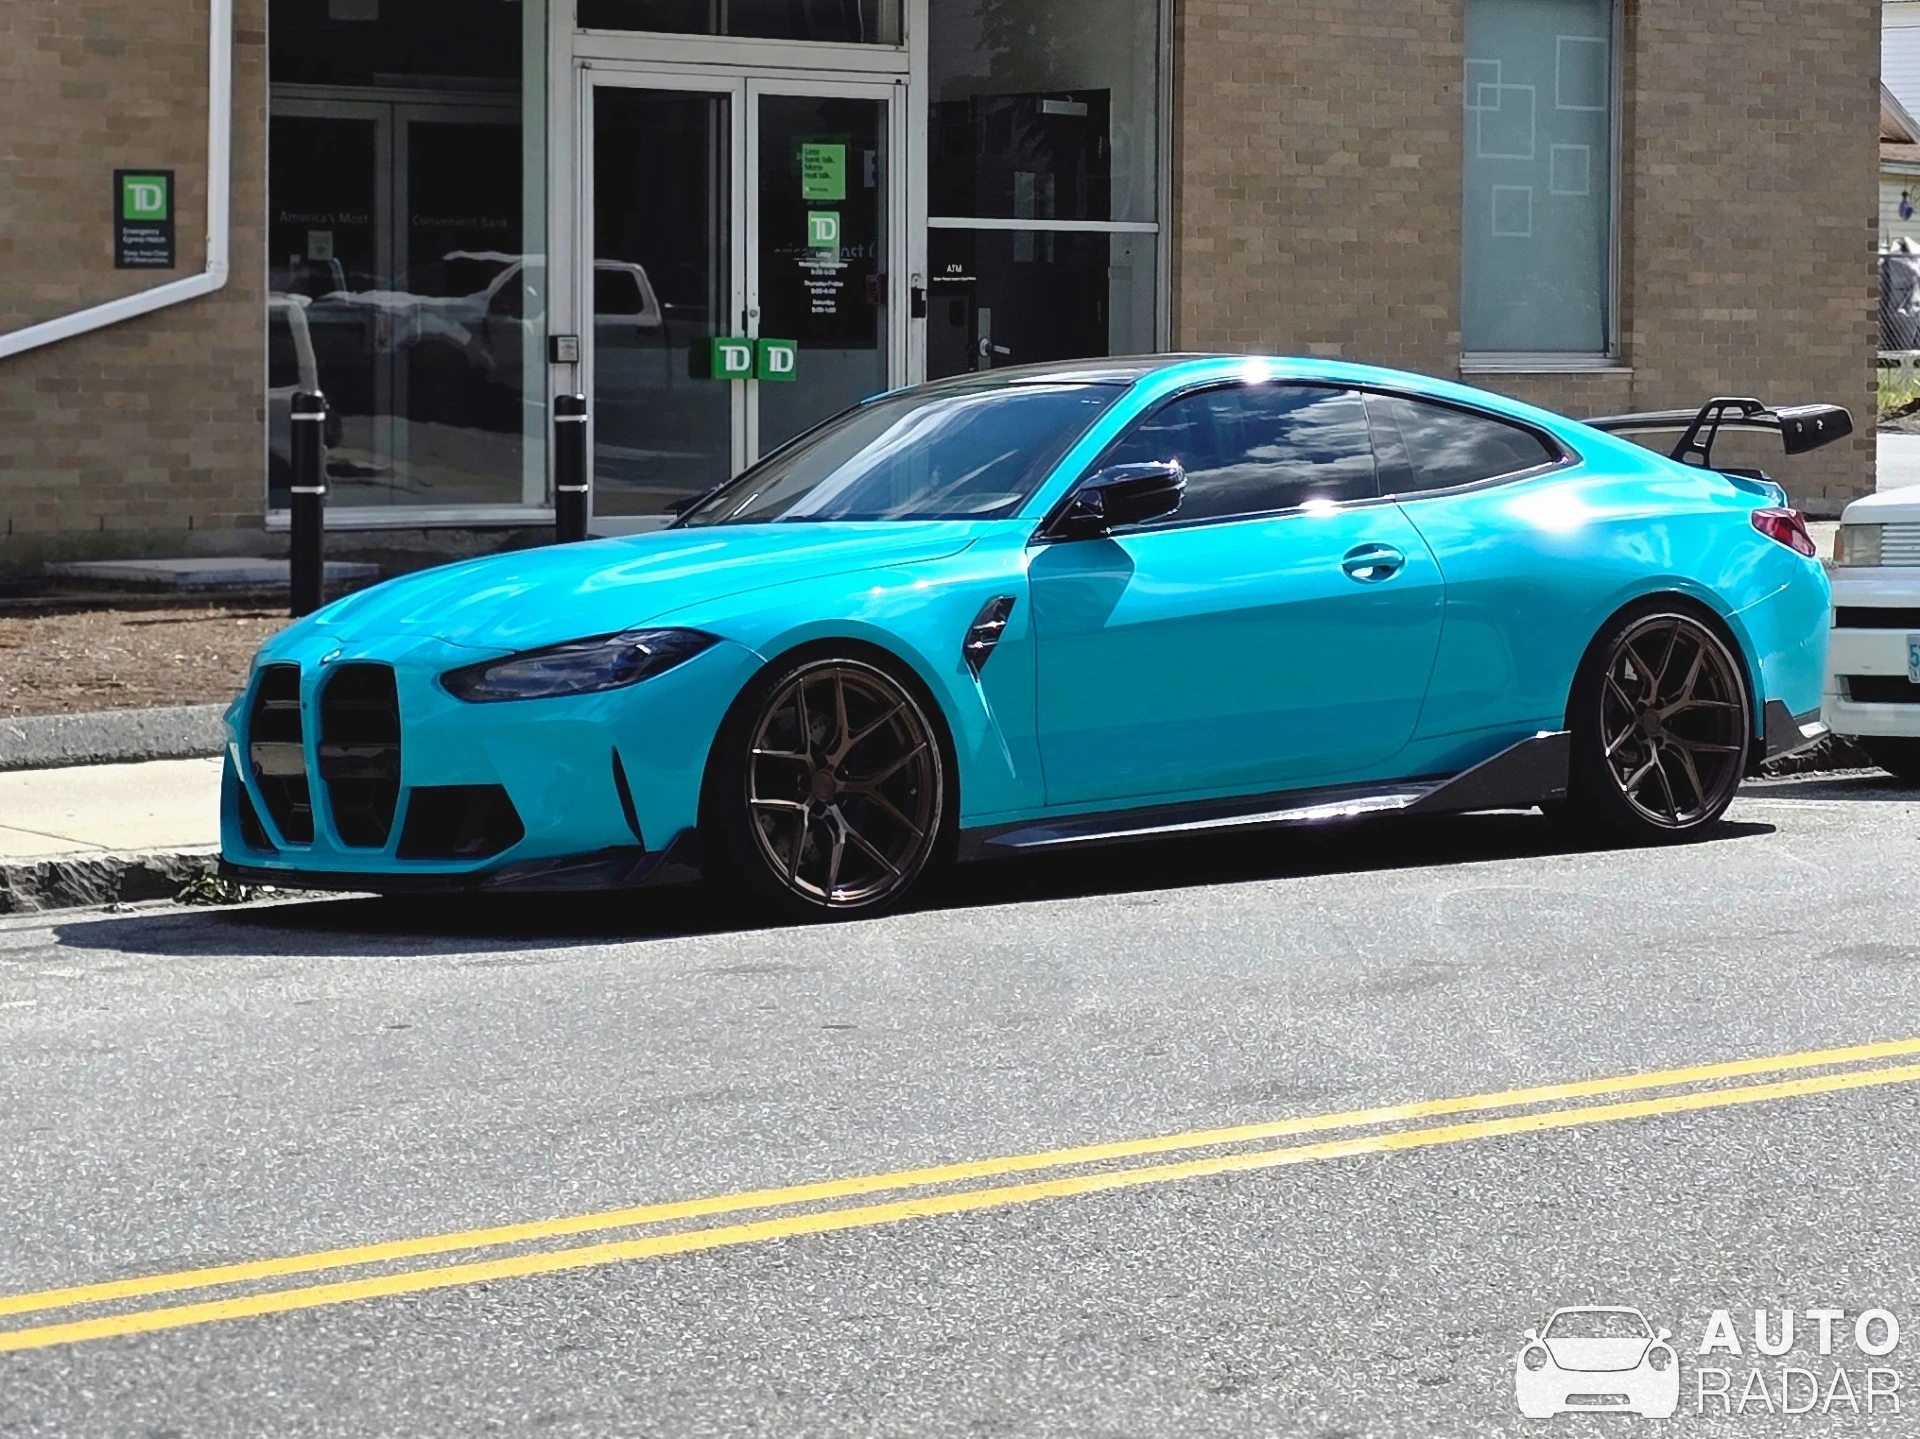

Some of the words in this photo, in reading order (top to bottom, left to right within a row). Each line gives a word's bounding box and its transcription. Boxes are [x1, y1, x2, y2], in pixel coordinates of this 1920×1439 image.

[128, 184, 162, 211] TD
[338, 212, 369, 225] Most
[480, 216, 508, 228] Bank
[811, 217, 837, 240] TD
[946, 264, 963, 273] ATM
[719, 345, 751, 371] TD
[767, 346, 794, 372] TD
